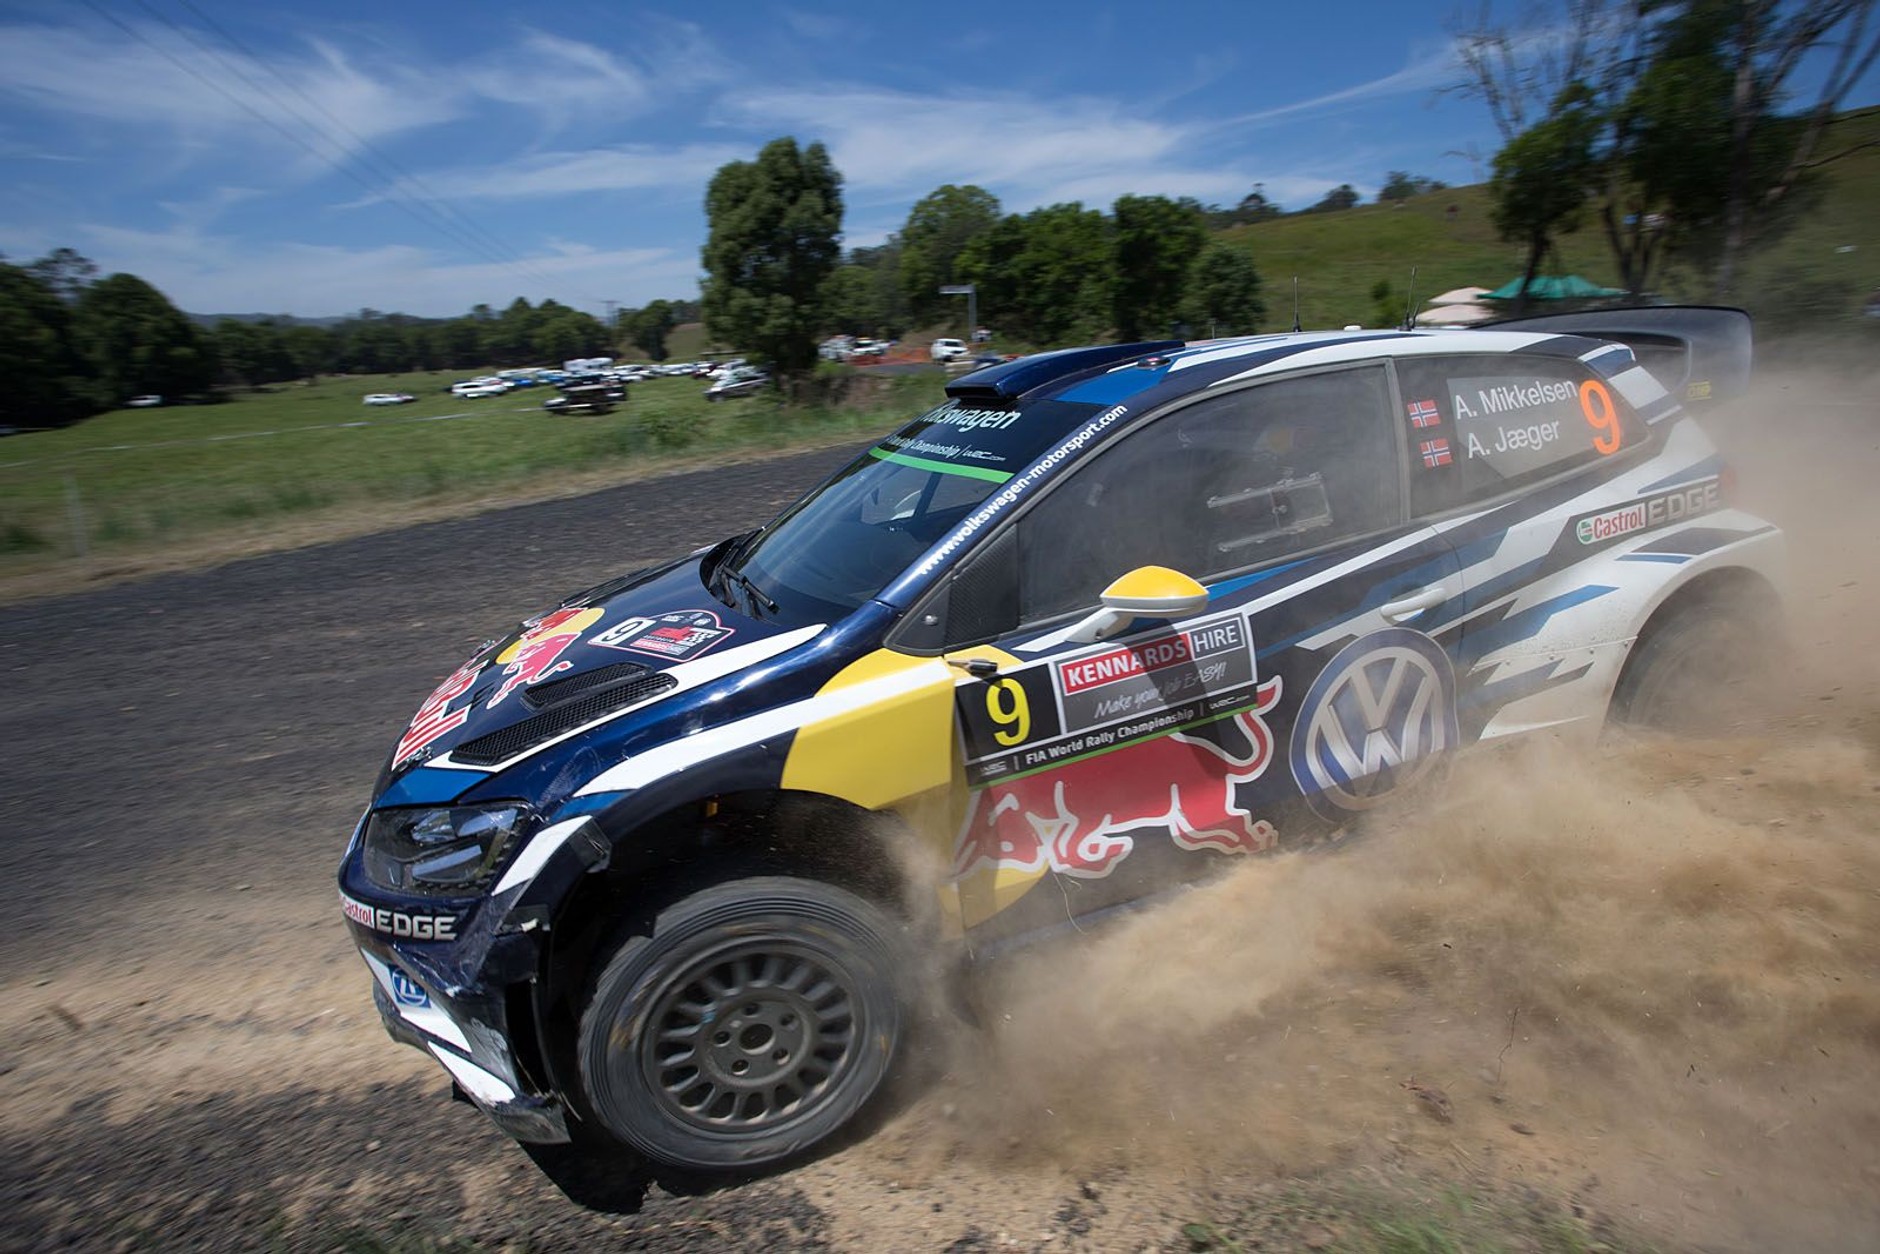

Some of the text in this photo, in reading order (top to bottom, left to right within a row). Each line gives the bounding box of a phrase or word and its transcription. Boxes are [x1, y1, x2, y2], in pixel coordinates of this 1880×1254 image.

[1455, 379, 1577, 420] A. Mikkelsen
[1578, 379, 1621, 455] 9
[1467, 419, 1560, 459] A. Jæger
[1593, 481, 1718, 539] Castrol EDGE
[1067, 624, 1238, 688] KENNARDS HIRE
[986, 678, 1031, 746] 9
[1094, 693, 1130, 719] Make
[1025, 708, 1194, 765] FIA World Rally Championship
[376, 908, 457, 940] EDGE
